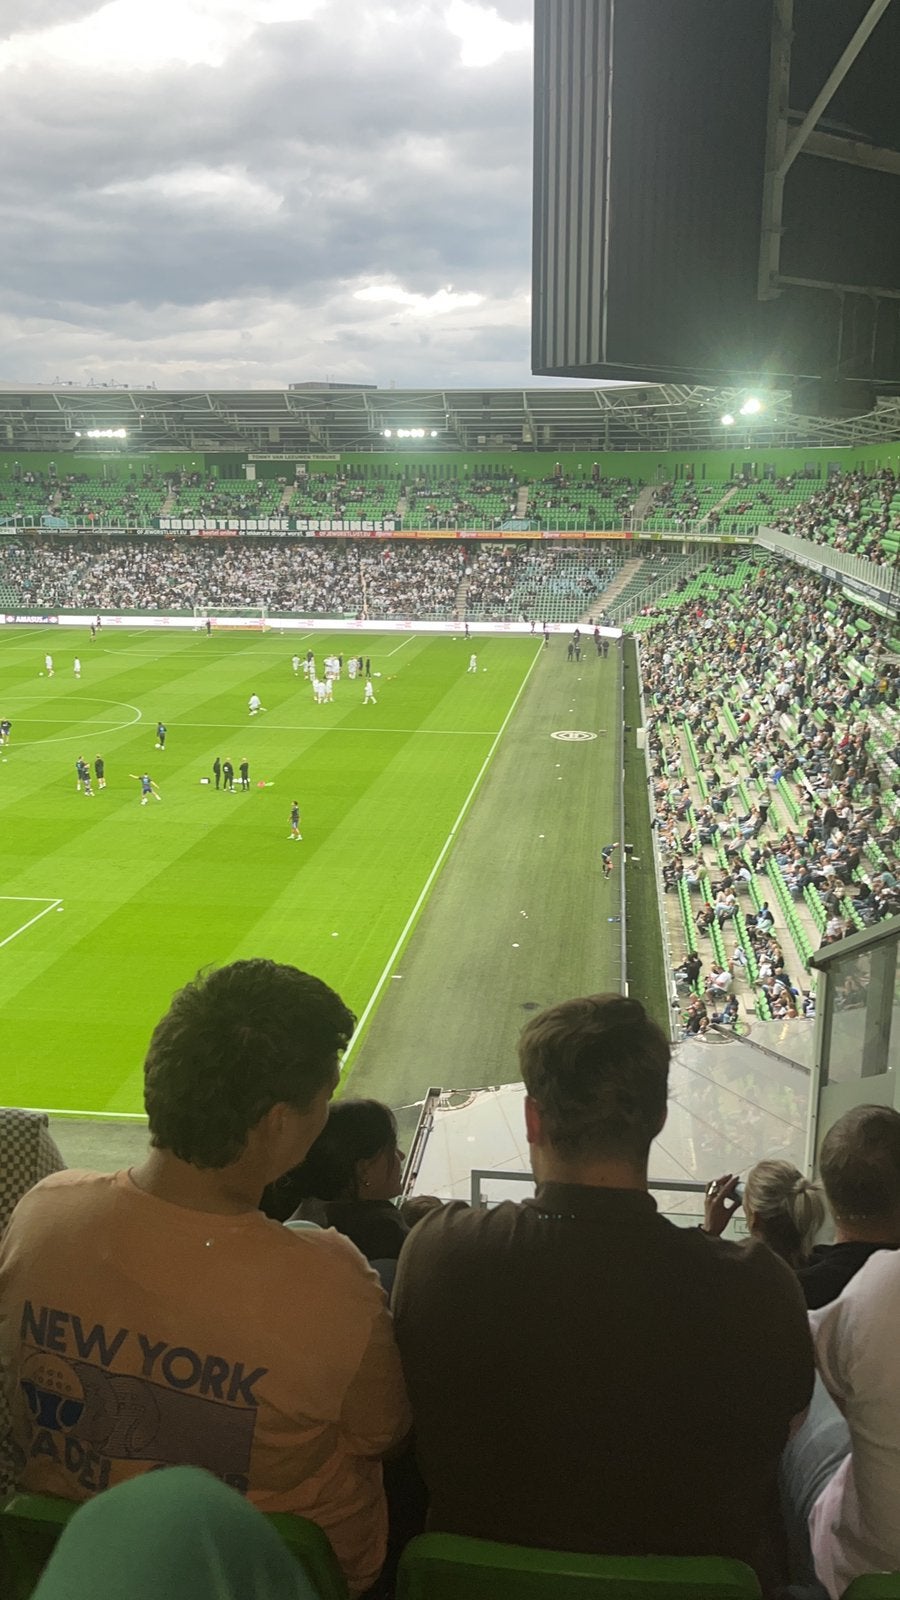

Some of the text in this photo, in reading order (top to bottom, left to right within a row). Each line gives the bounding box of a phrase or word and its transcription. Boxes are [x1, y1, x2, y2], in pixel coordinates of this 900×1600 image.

[296, 520, 395, 531] GRONINGEN
[20, 1300, 268, 1407] NEW YORK
